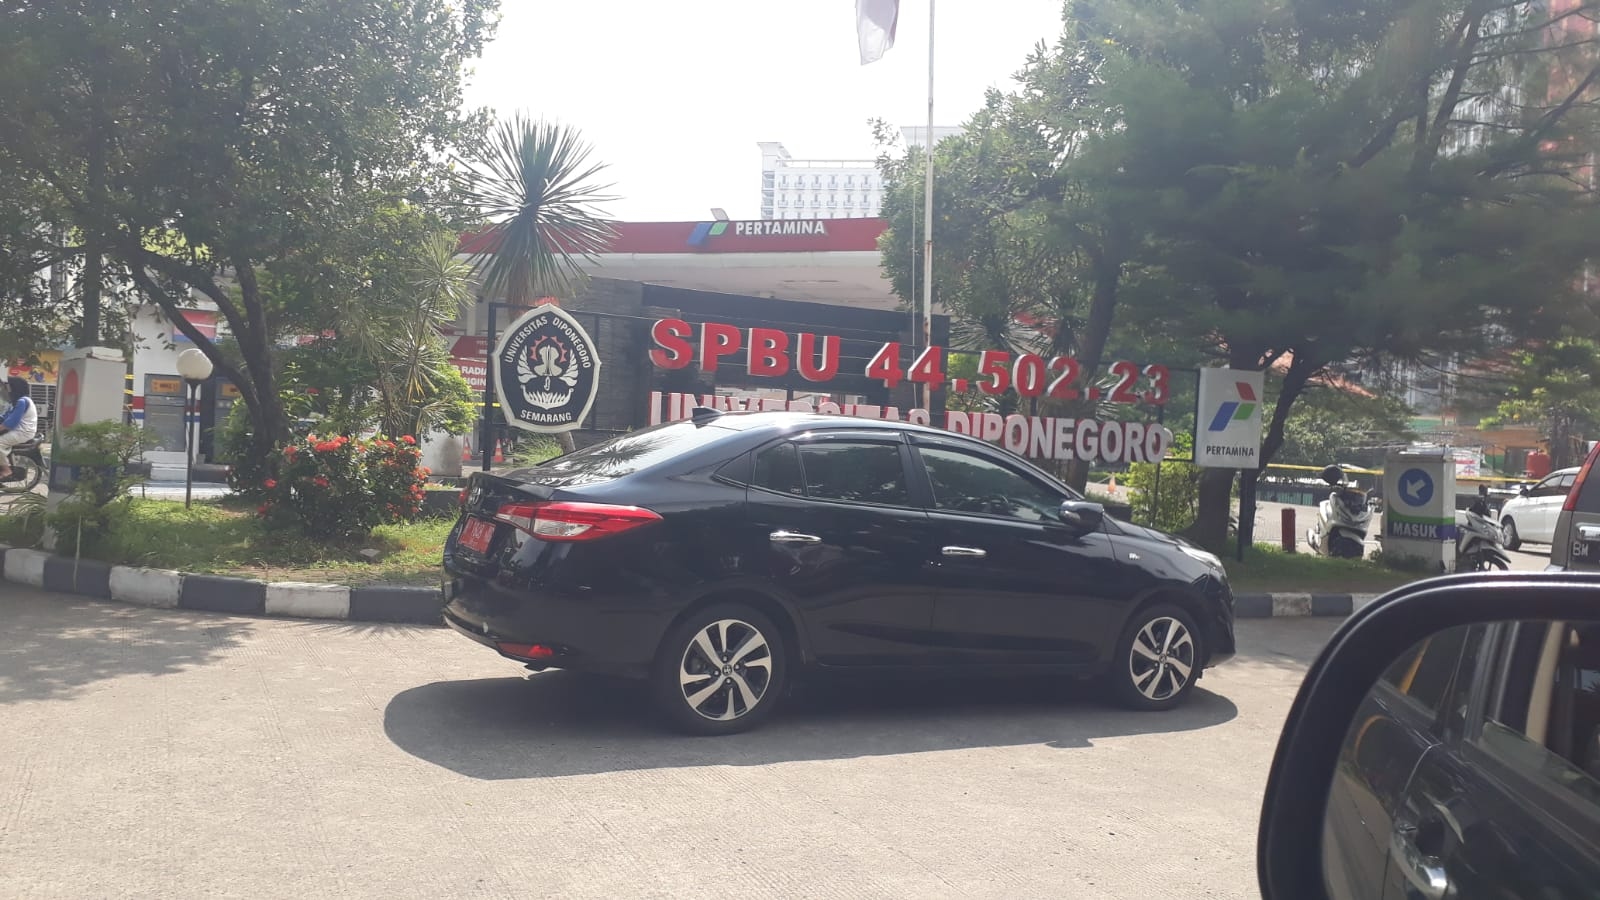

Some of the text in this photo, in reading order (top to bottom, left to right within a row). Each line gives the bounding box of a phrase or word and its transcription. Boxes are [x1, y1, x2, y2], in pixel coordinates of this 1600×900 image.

[735, 220, 825, 236] PERTAMINA
[504, 315, 591, 369] UNIVERSITAS DIPONEGORO
[649, 318, 1171, 405] SPBU 44.502.23
[520, 409, 572, 422] SEMARANG
[1206, 445, 1254, 457] PERTAMINA
[1392, 521, 1438, 538] MASUK
